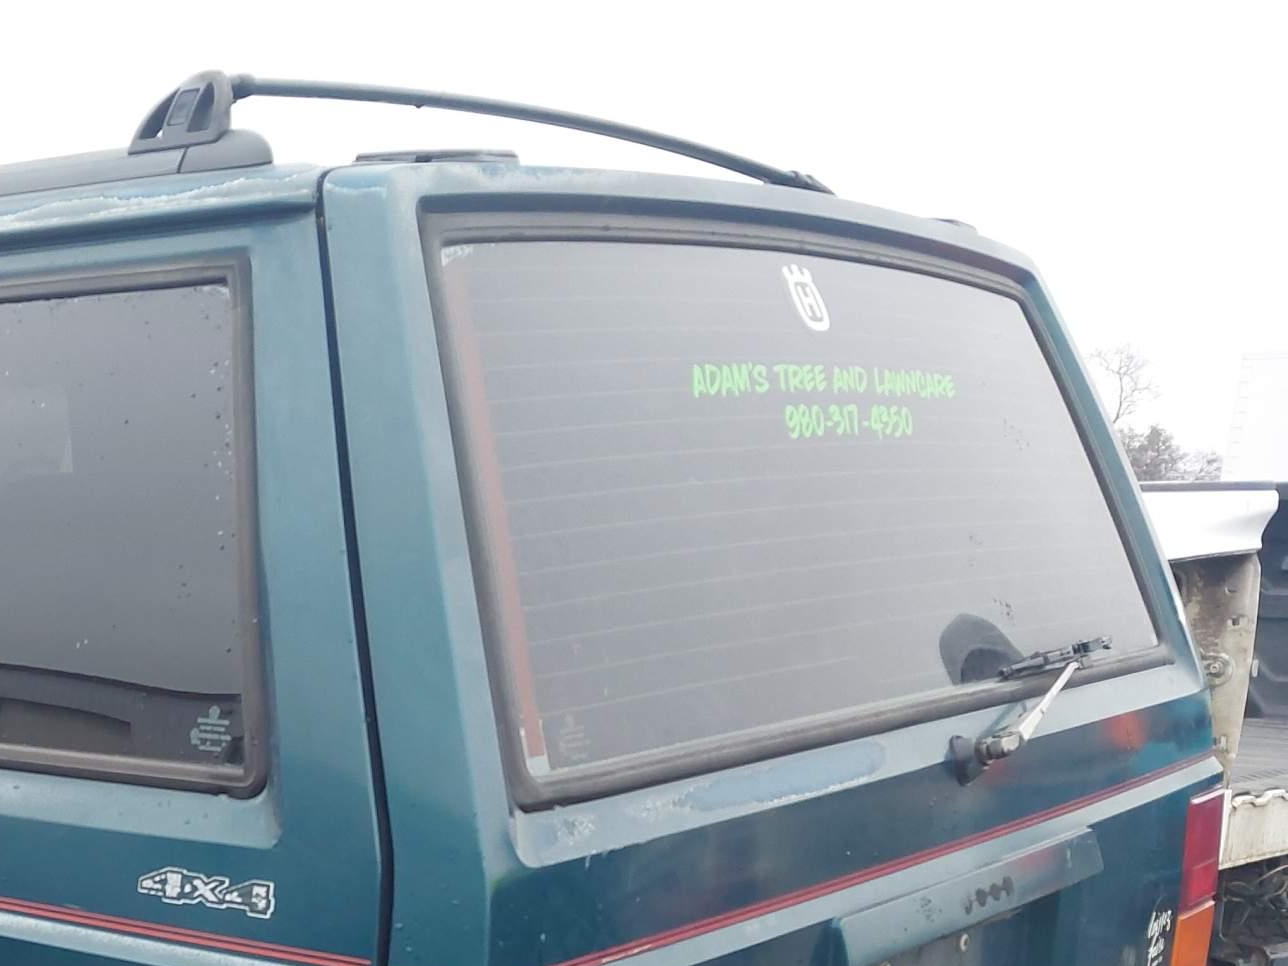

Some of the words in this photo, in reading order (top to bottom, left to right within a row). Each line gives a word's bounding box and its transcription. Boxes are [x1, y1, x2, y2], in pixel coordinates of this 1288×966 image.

[693, 362, 770, 398] ADAM'S
[773, 364, 828, 392] TREE
[832, 366, 868, 393] AND
[874, 367, 956, 398] LAWNCARE
